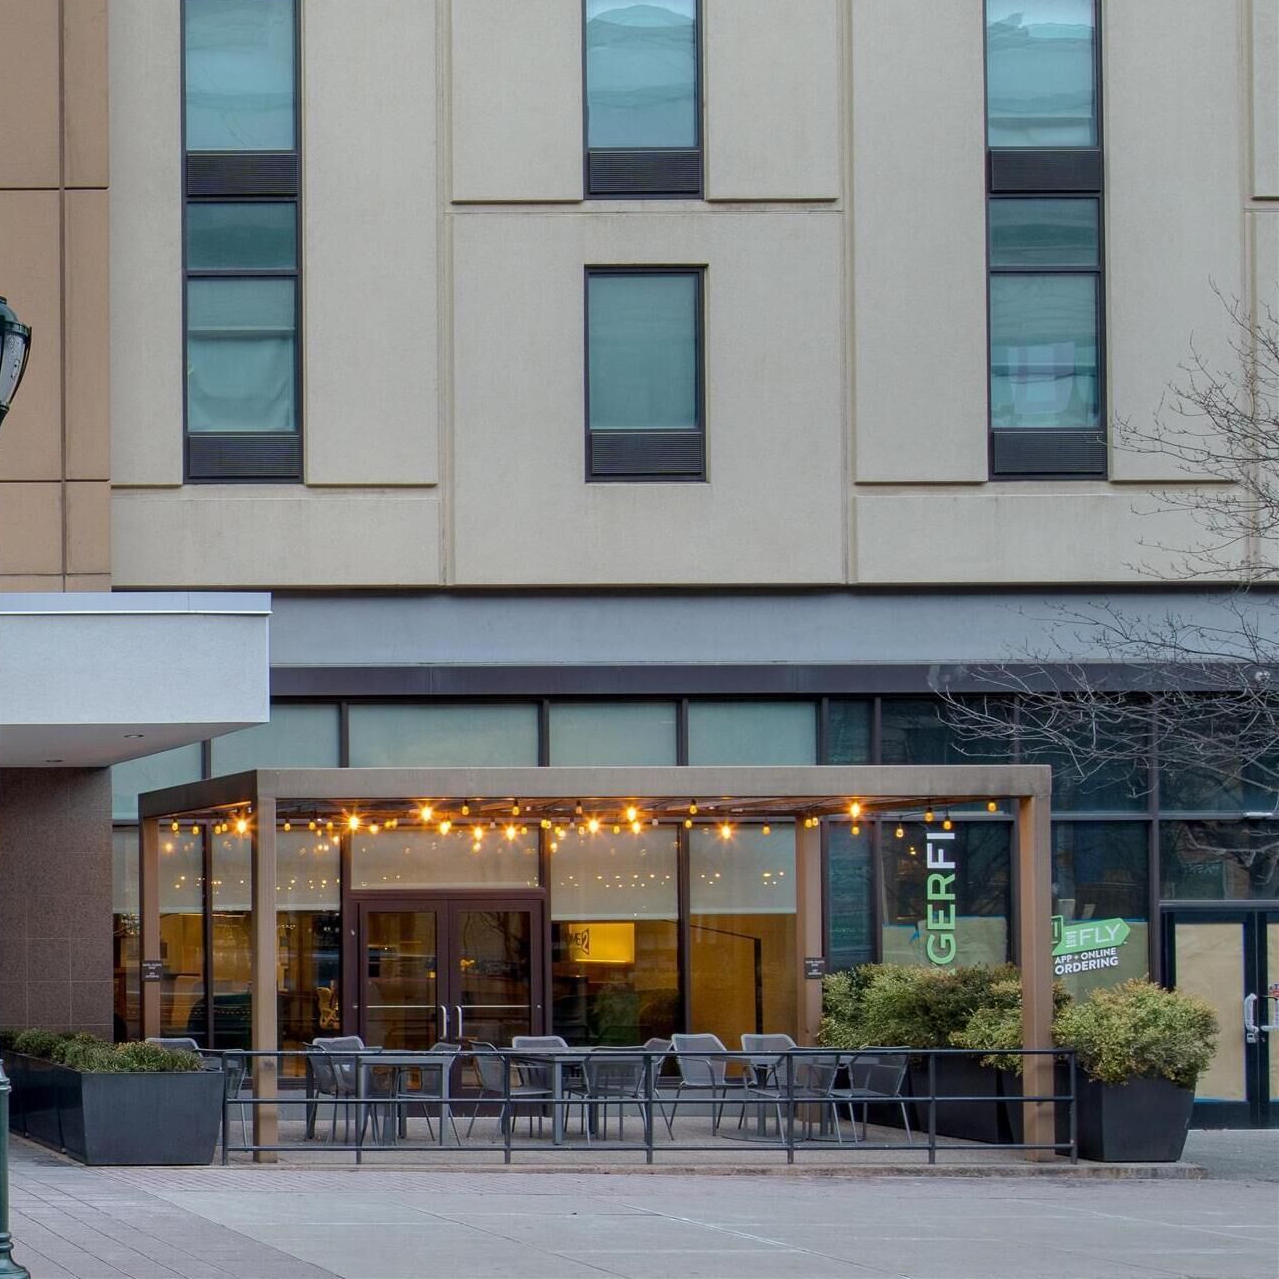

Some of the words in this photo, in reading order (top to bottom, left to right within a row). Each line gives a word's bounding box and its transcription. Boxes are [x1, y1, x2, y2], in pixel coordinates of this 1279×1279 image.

[926, 832, 956, 972] GERFI
[1079, 923, 1121, 946] FLY
[1054, 955, 1072, 964] APP
[1081, 947, 1117, 961] ONLINE
[1054, 956, 1119, 975] ORDERING
